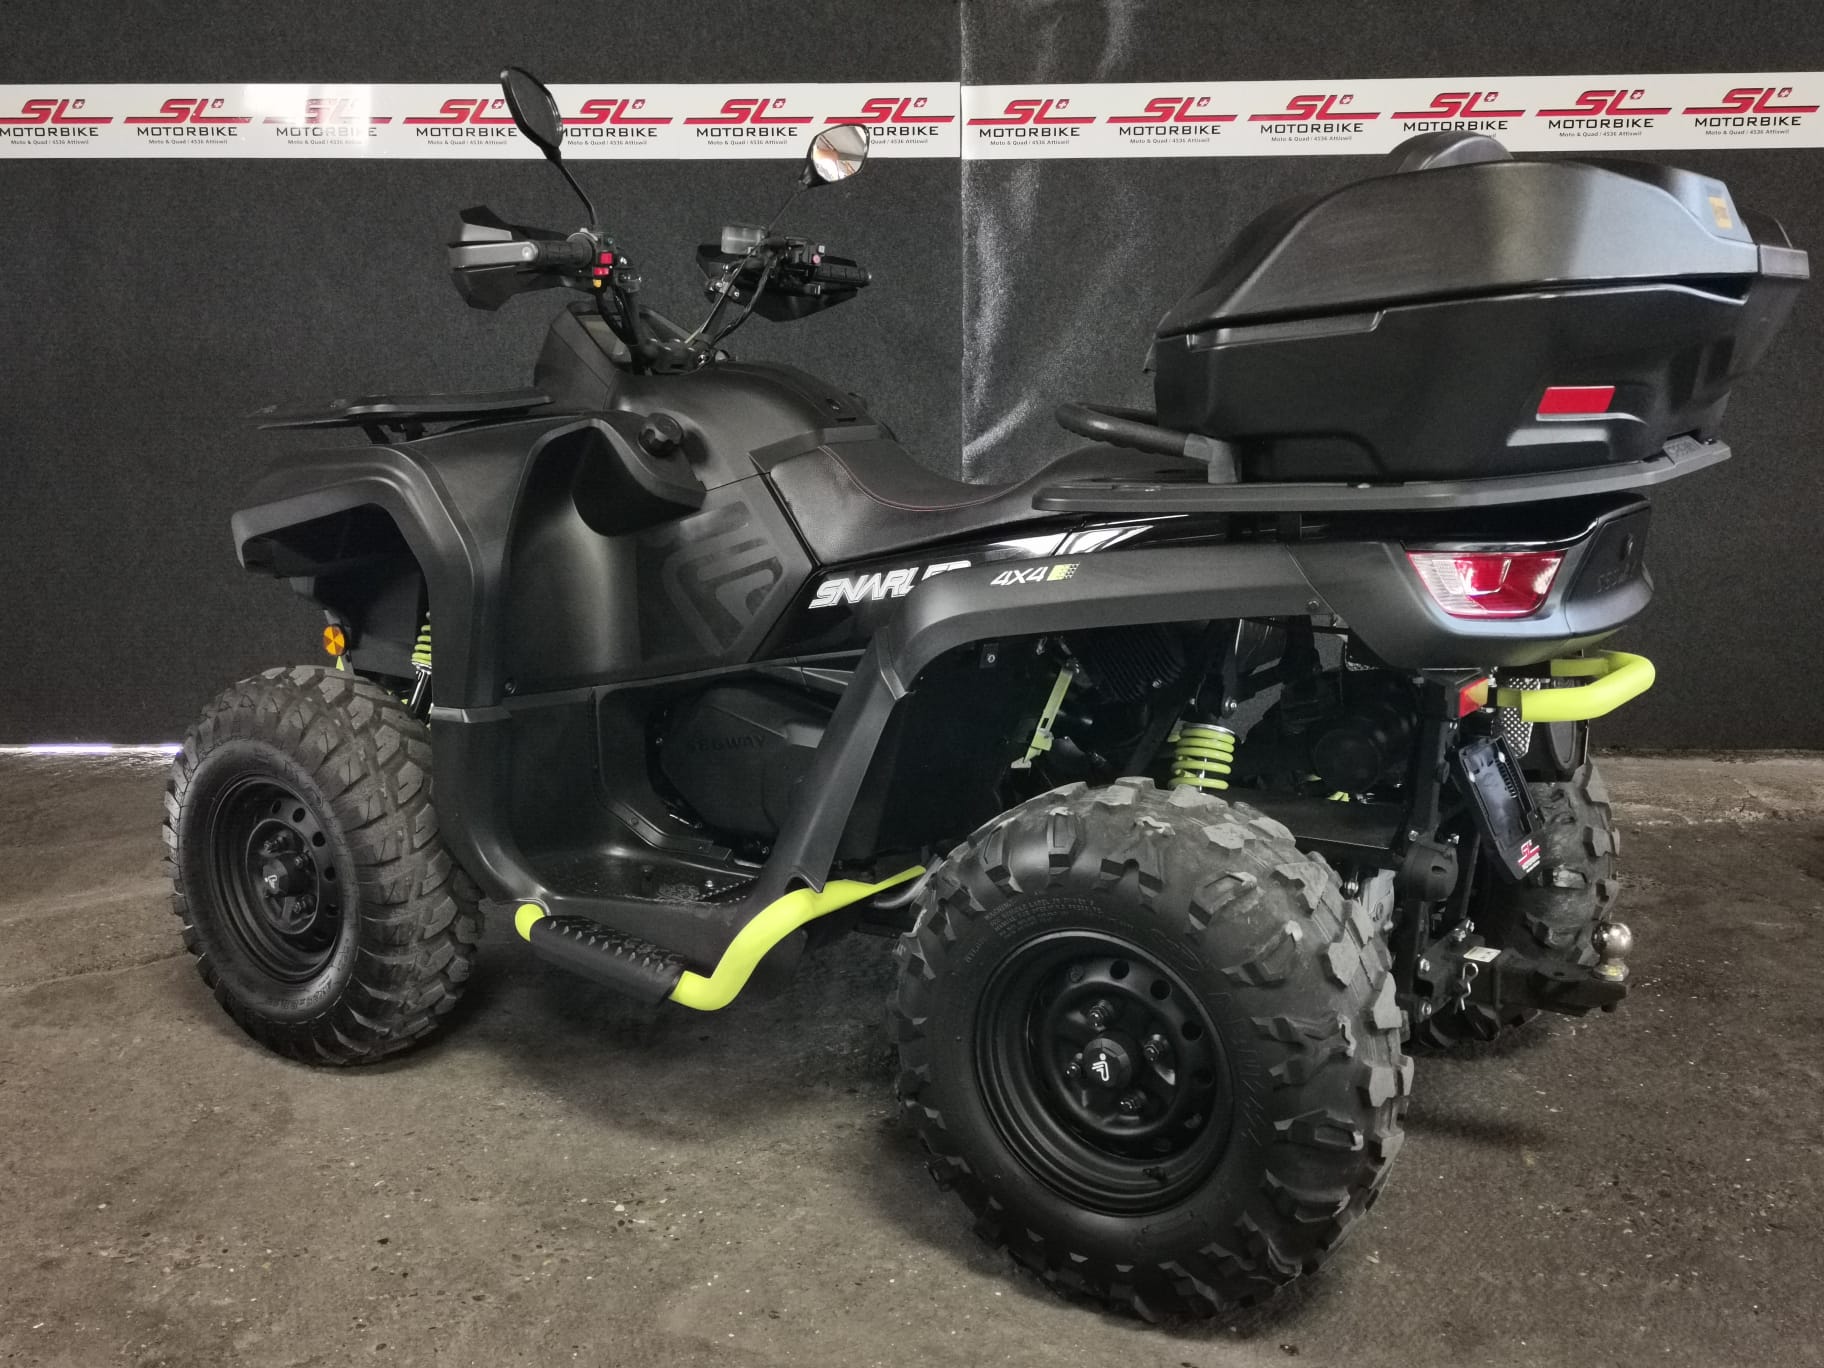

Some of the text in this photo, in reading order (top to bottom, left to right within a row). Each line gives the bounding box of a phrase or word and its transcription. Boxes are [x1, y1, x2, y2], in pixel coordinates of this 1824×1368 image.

[1403, 121, 1508, 131] MOTORBIKE
[1548, 118, 1654, 129] MOTORBIKE
[1695, 116, 1801, 127] MOTORBIKE
[0, 127, 99, 136] MOTORBIKE
[137, 127, 237, 136] MOTORBIKE
[277, 127, 377, 136] MOTORBIE
[416, 127, 517, 137] MOTORBIKE
[697, 127, 798, 137] MOTORBIKE
[980, 127, 1080, 137] MOTORBIKE
[1120, 125, 1221, 136] MOTORBIKE
[1261, 123, 1364, 134] MOTORBIKE
[808, 560, 972, 609] SNARL
